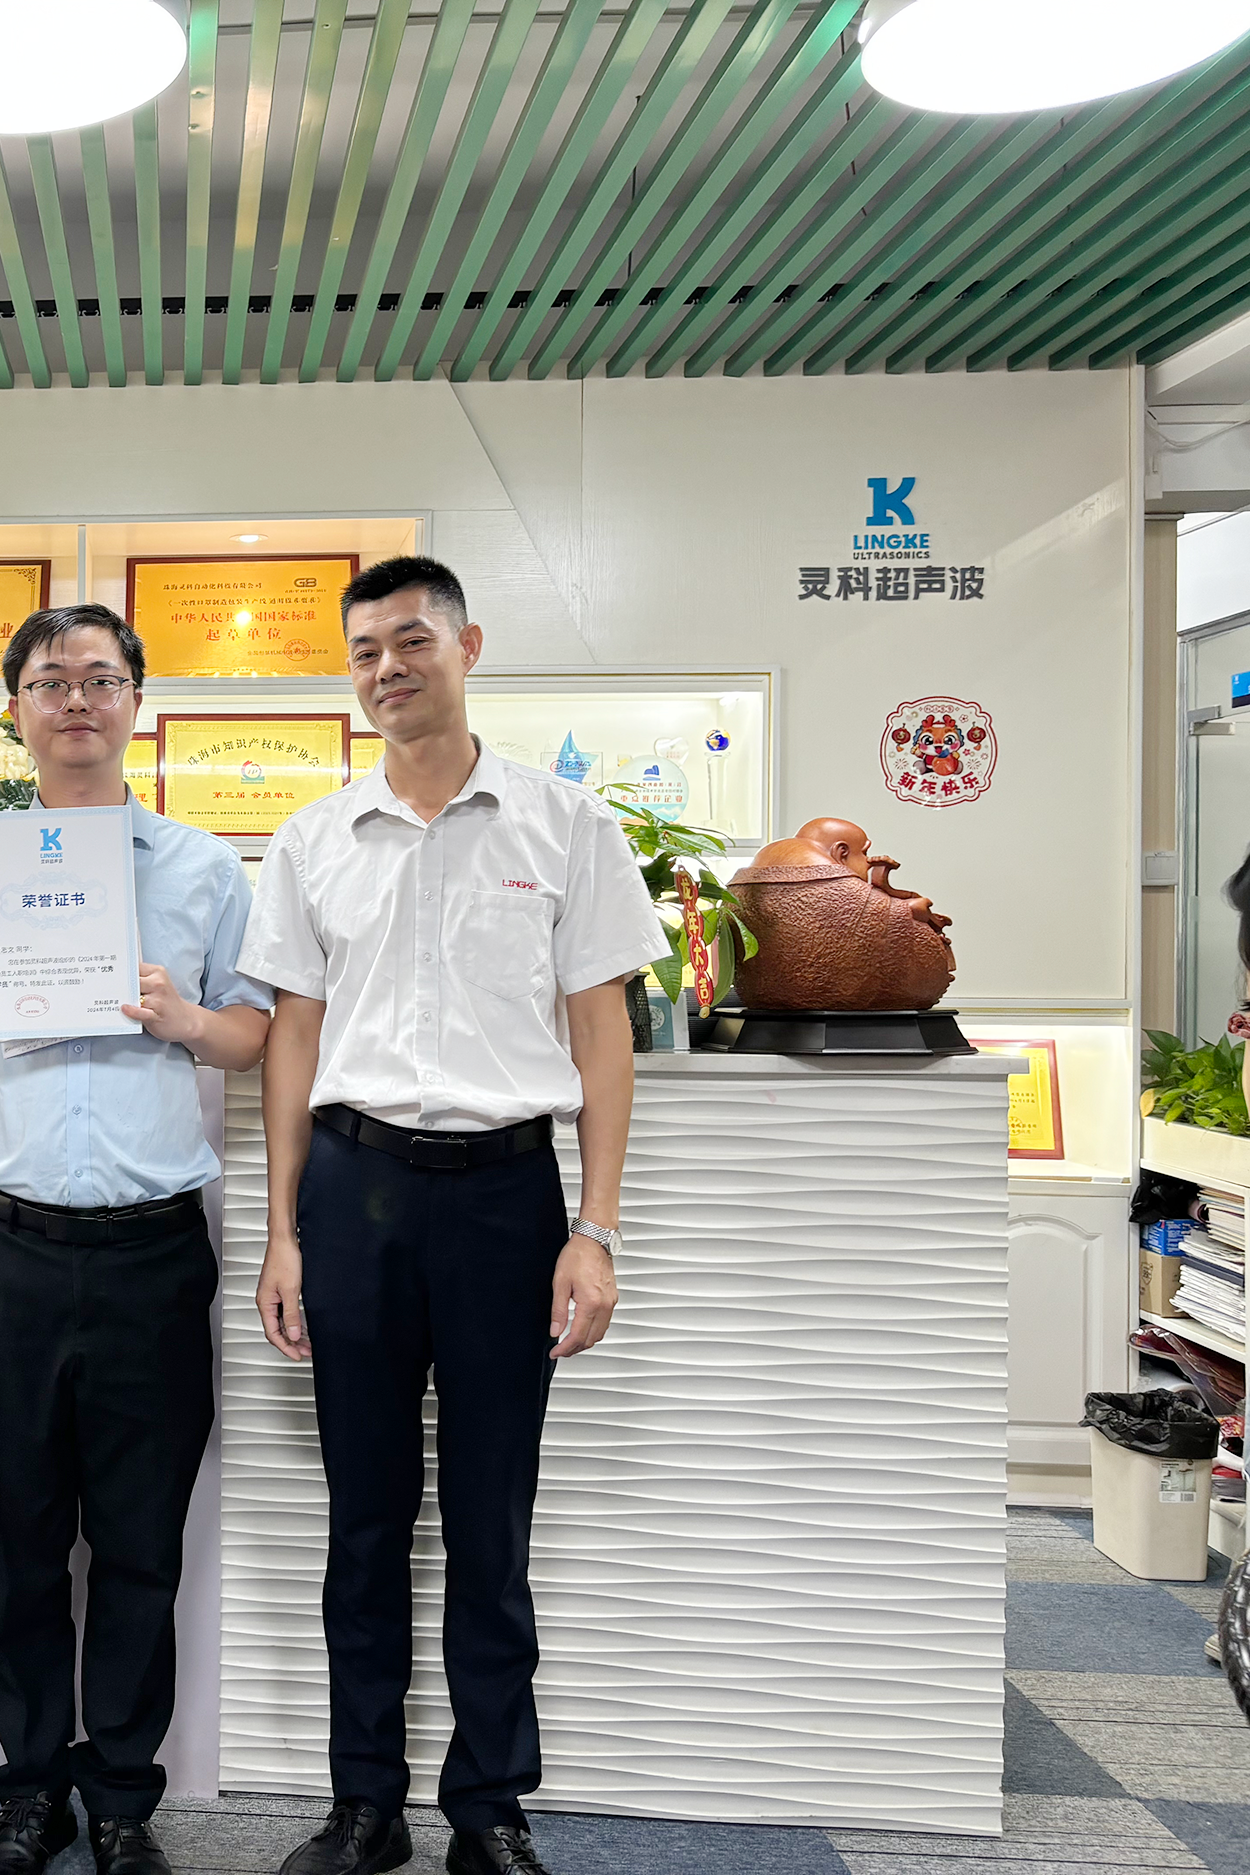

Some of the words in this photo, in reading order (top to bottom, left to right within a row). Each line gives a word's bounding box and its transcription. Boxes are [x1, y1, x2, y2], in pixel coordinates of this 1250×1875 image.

[853, 533, 930, 550] LINGKE
[853, 551, 930, 561] ULTRASONICS
[798, 565, 986, 602] 灵科超声波
[171, 610, 317, 624] 中华人民共国国家标准
[206, 628, 281, 641] 起草单位
[188, 737, 320, 768] 珠海市知识产权保护协会
[898, 771, 980, 797] 新年快乐
[502, 879, 538, 890] LINGKE
[22, 892, 85, 909] 荣誉证书
